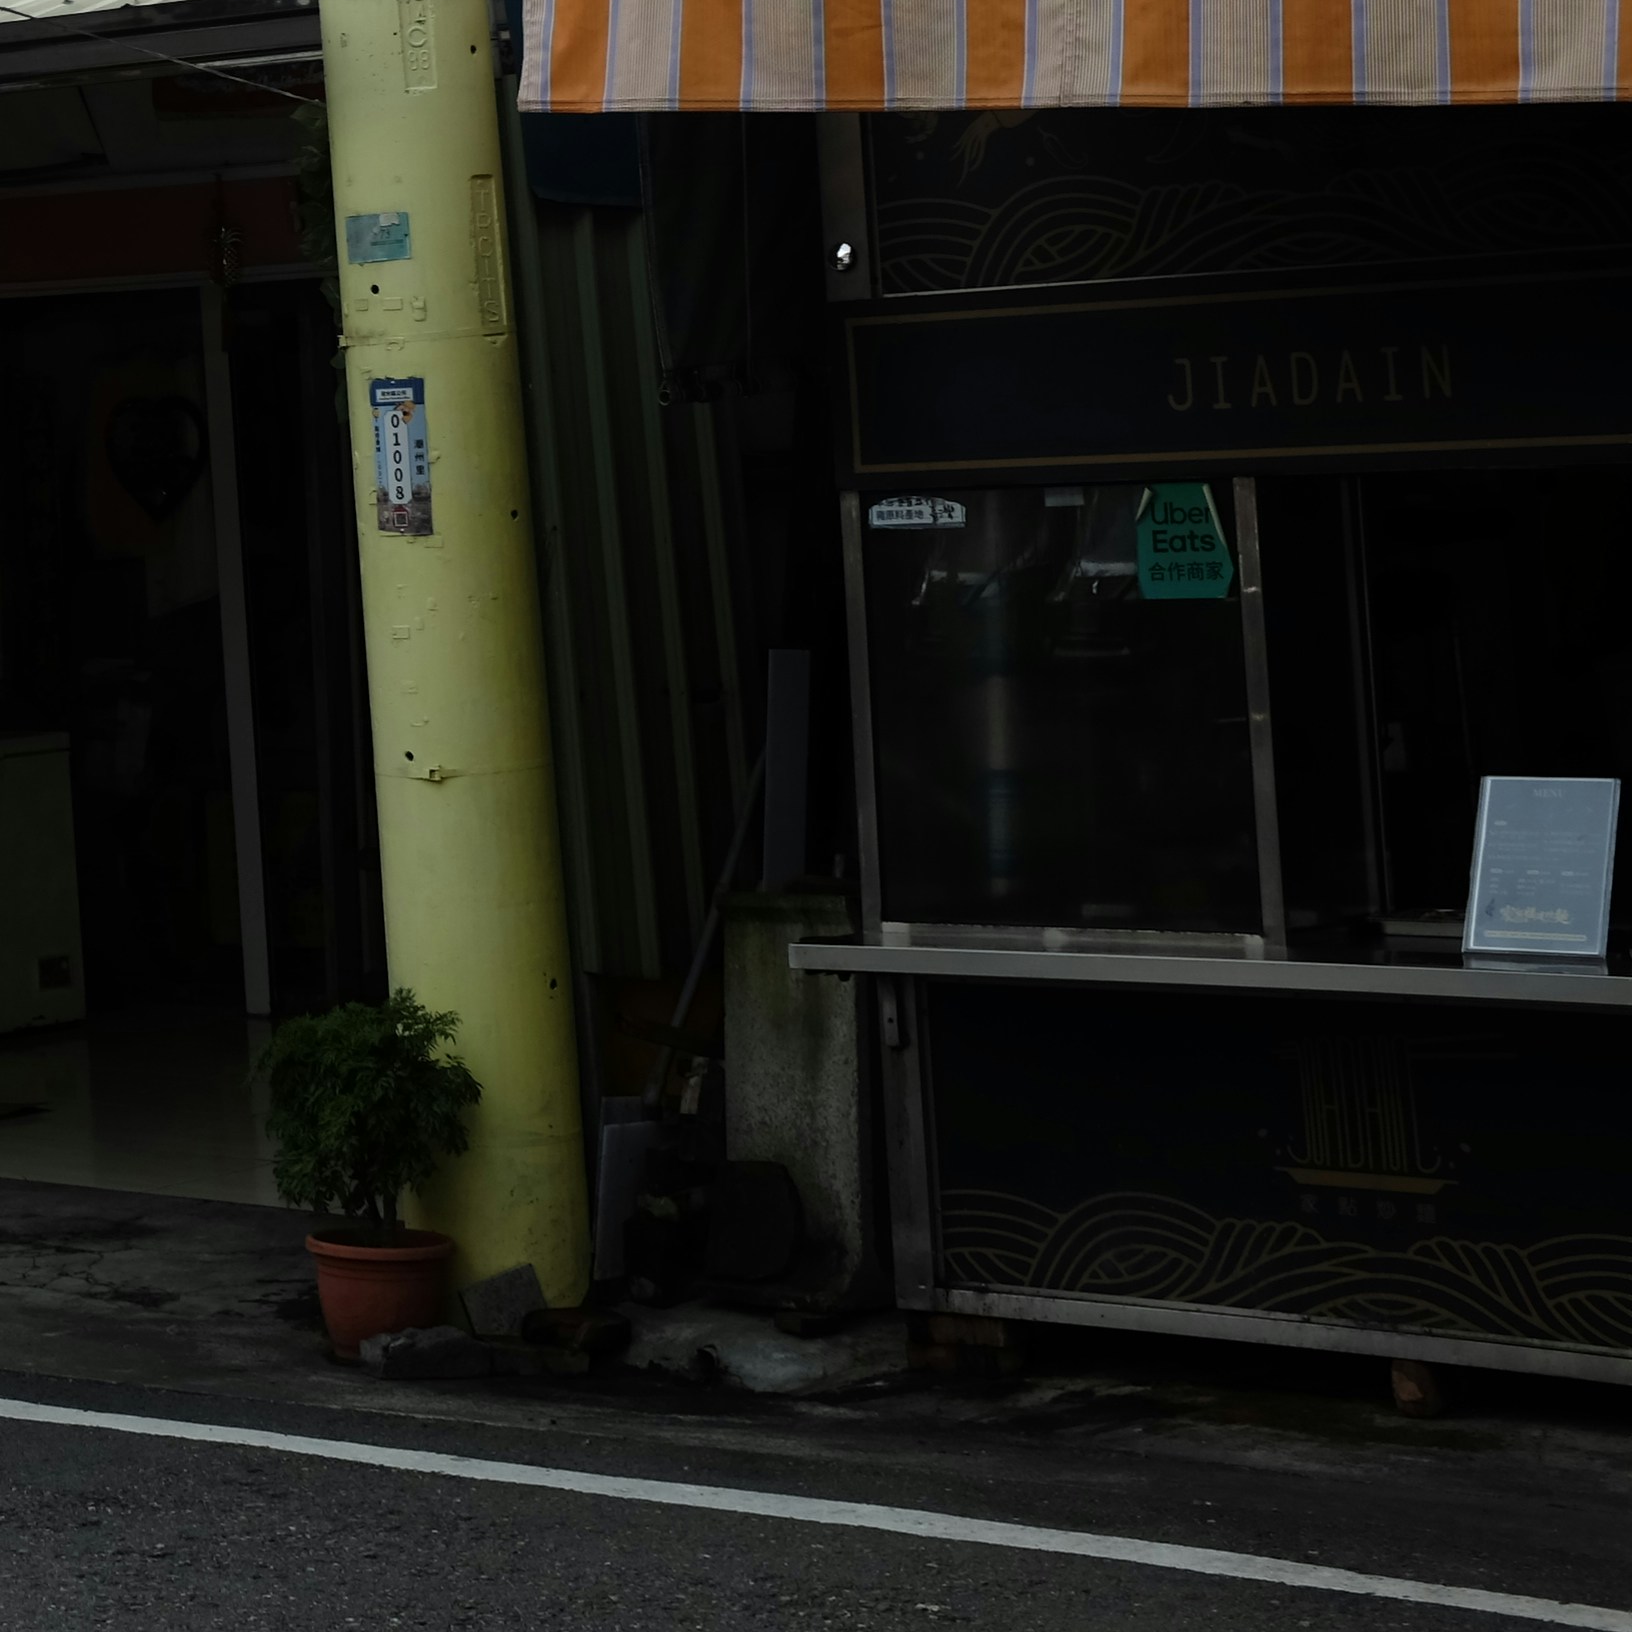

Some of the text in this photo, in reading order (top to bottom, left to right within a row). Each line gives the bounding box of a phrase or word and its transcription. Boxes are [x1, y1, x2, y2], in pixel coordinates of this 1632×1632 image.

[1167, 345, 1455, 412] JIADAIN
[391, 414, 405, 500] 01008
[1151, 502, 1210, 524] Uber
[1152, 530, 1216, 553] Eats
[1148, 562, 1224, 581] 合作商家
